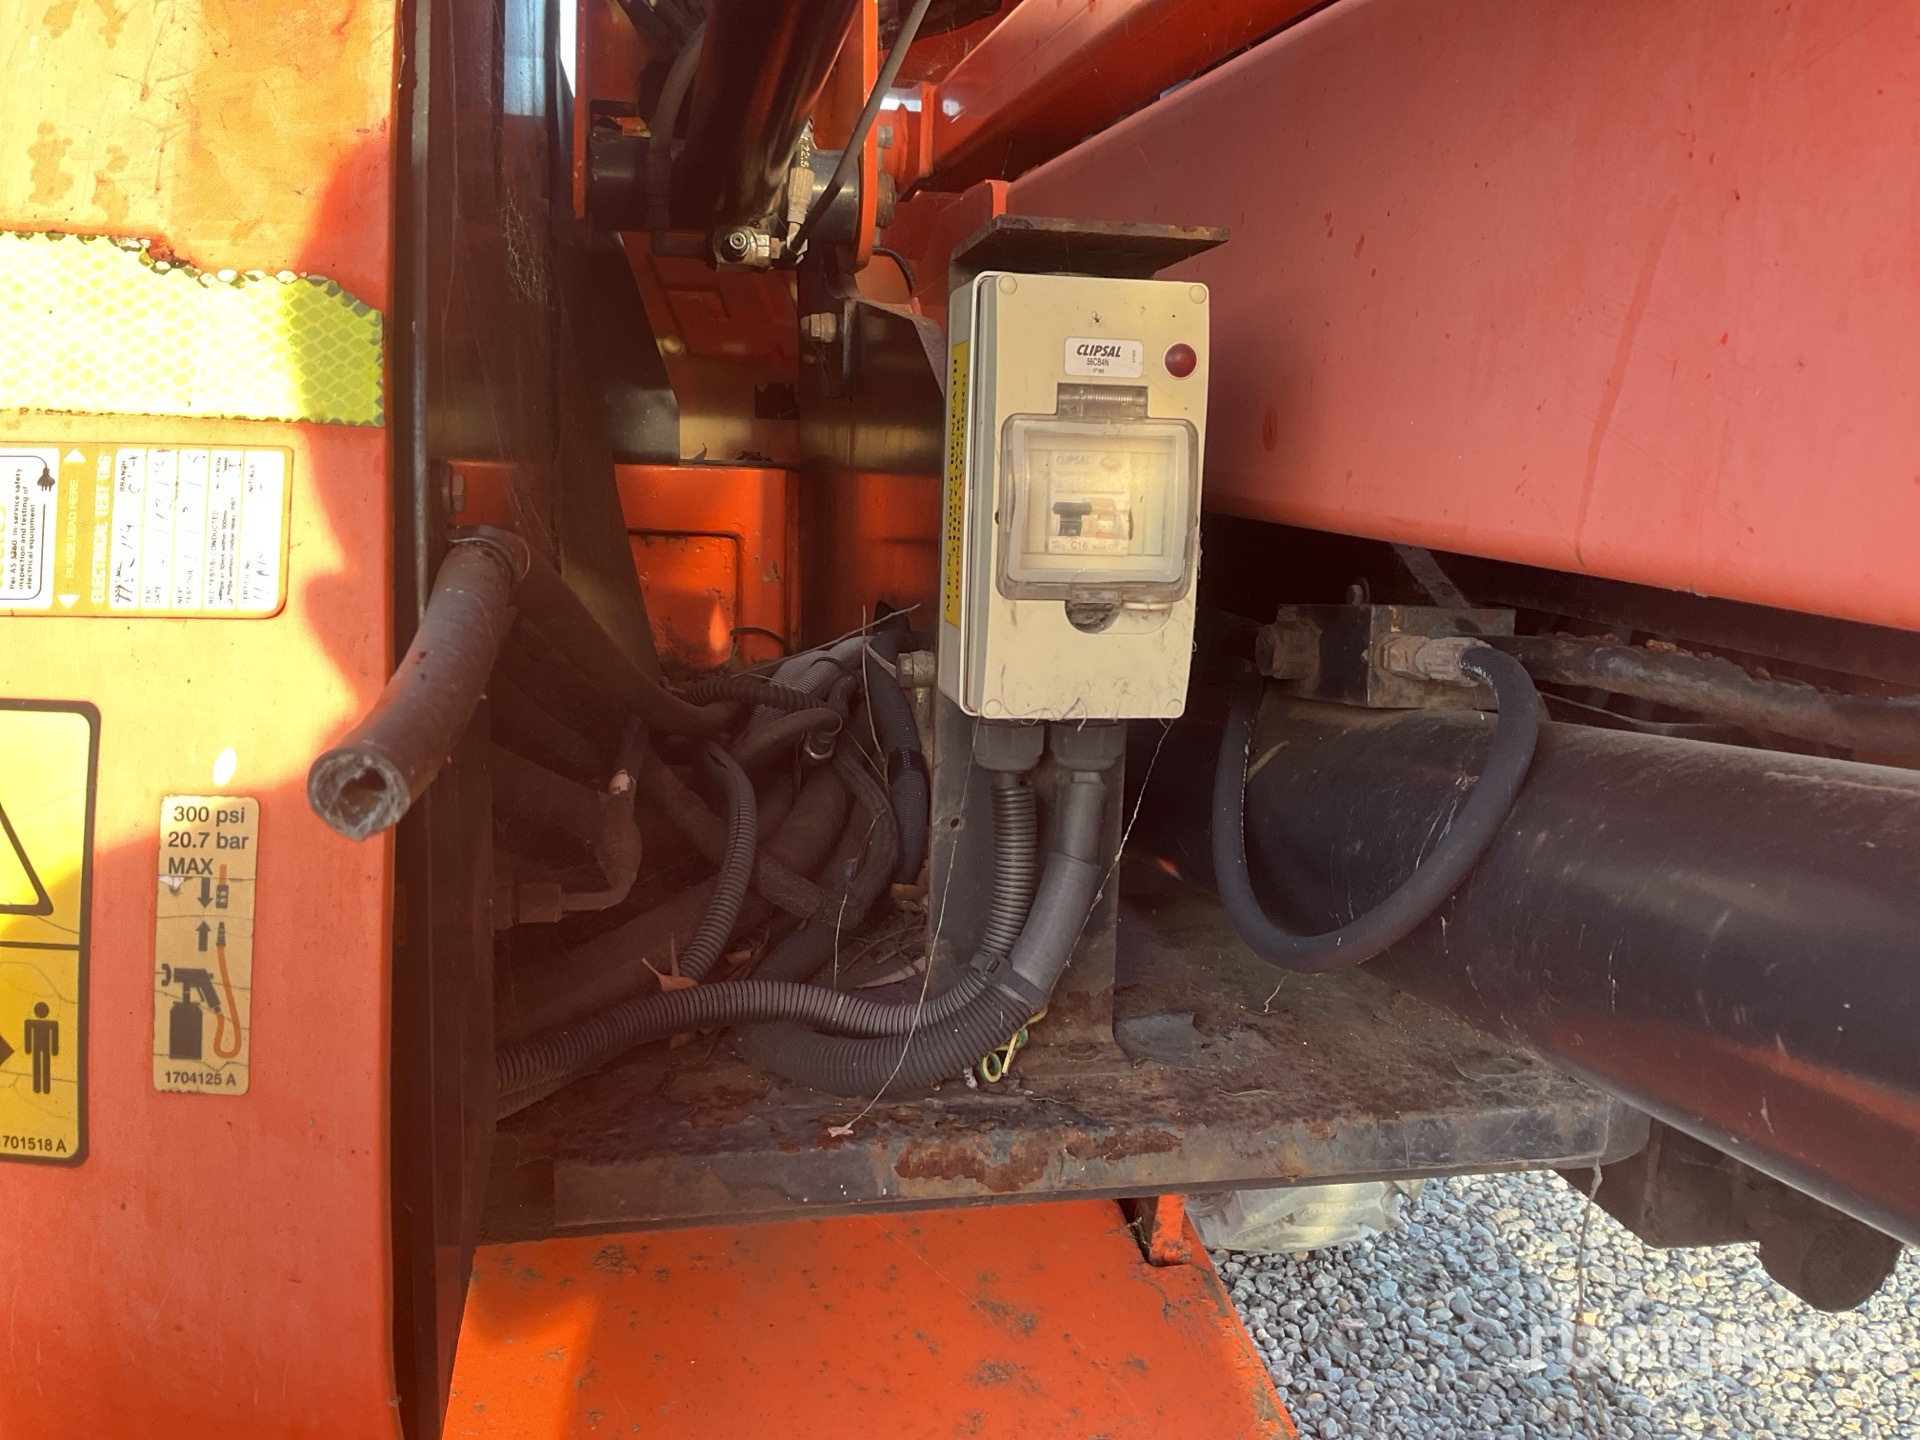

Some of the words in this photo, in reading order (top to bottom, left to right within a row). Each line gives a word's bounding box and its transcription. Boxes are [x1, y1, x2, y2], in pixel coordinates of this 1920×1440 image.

[1077, 344, 1121, 357] CLIPSAL
[950, 359, 958, 465] BENEATH
[95, 455, 111, 481] TAG
[22, 486, 28, 494] of
[68, 480, 79, 509] HERE
[94, 484, 109, 517] TEST
[10, 563, 16, 574] AS
[14, 468, 22, 493] safety
[20, 497, 29, 526] testing
[28, 504, 36, 549] equipment
[67, 512, 77, 540] LEAD
[18, 546, 27, 589] inspection
[65, 543, 76, 578] PLACE
[92, 523, 107, 603] ELECTRICAL
[173, 806, 209, 823] 300
[216, 806, 245, 826] psi
[168, 831, 210, 849] 20.7
[216, 832, 249, 850] bar
[168, 857, 214, 875] MAX
[164, 1071, 223, 1085] 1704125
[226, 1073, 236, 1087] A
[56, 1137, 67, 1153] A
